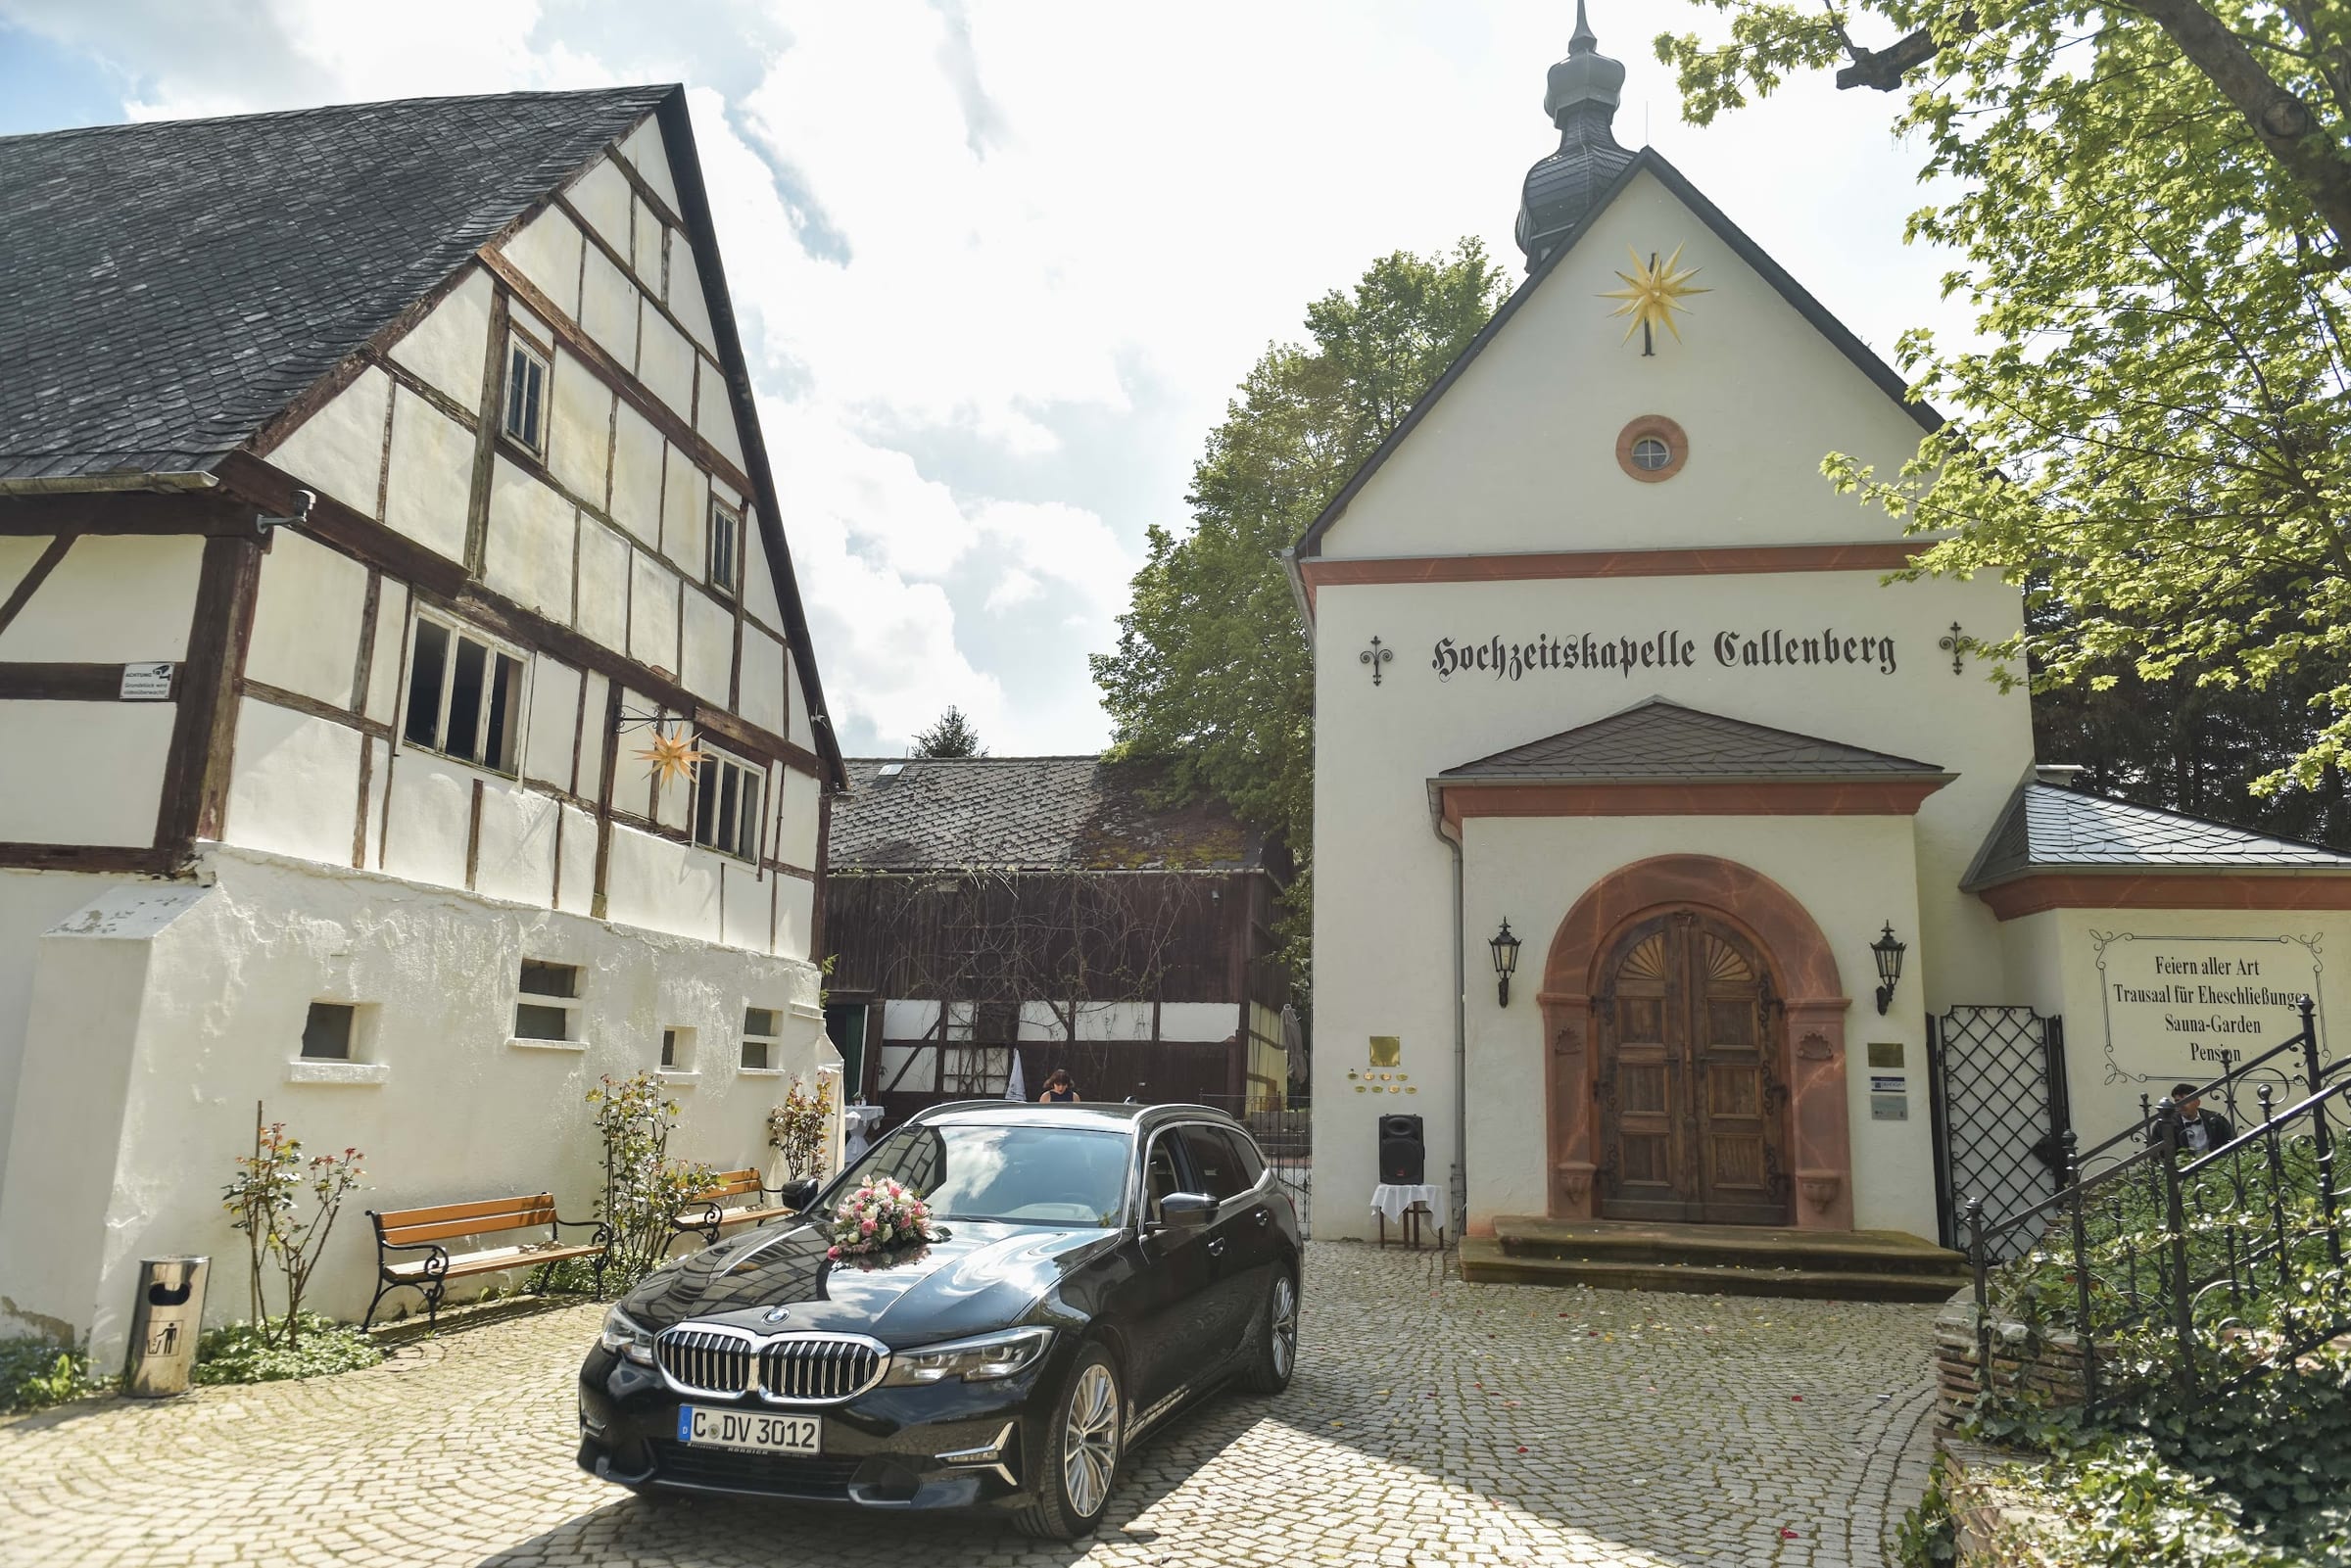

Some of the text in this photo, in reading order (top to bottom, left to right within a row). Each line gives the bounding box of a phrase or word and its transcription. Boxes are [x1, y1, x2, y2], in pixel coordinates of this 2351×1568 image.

[1432, 628, 1896, 683] Hochzeitskapelle Callenberg
[2155, 956, 2260, 975] Feiern aller Art
[2113, 983, 2171, 1003] Trausaal
[2175, 984, 2194, 1004] für
[2165, 1014, 2261, 1033] Sauna-Garden
[2190, 1043, 2241, 1063] Penson
[694, 1412, 816, 1449] C DV 3012
